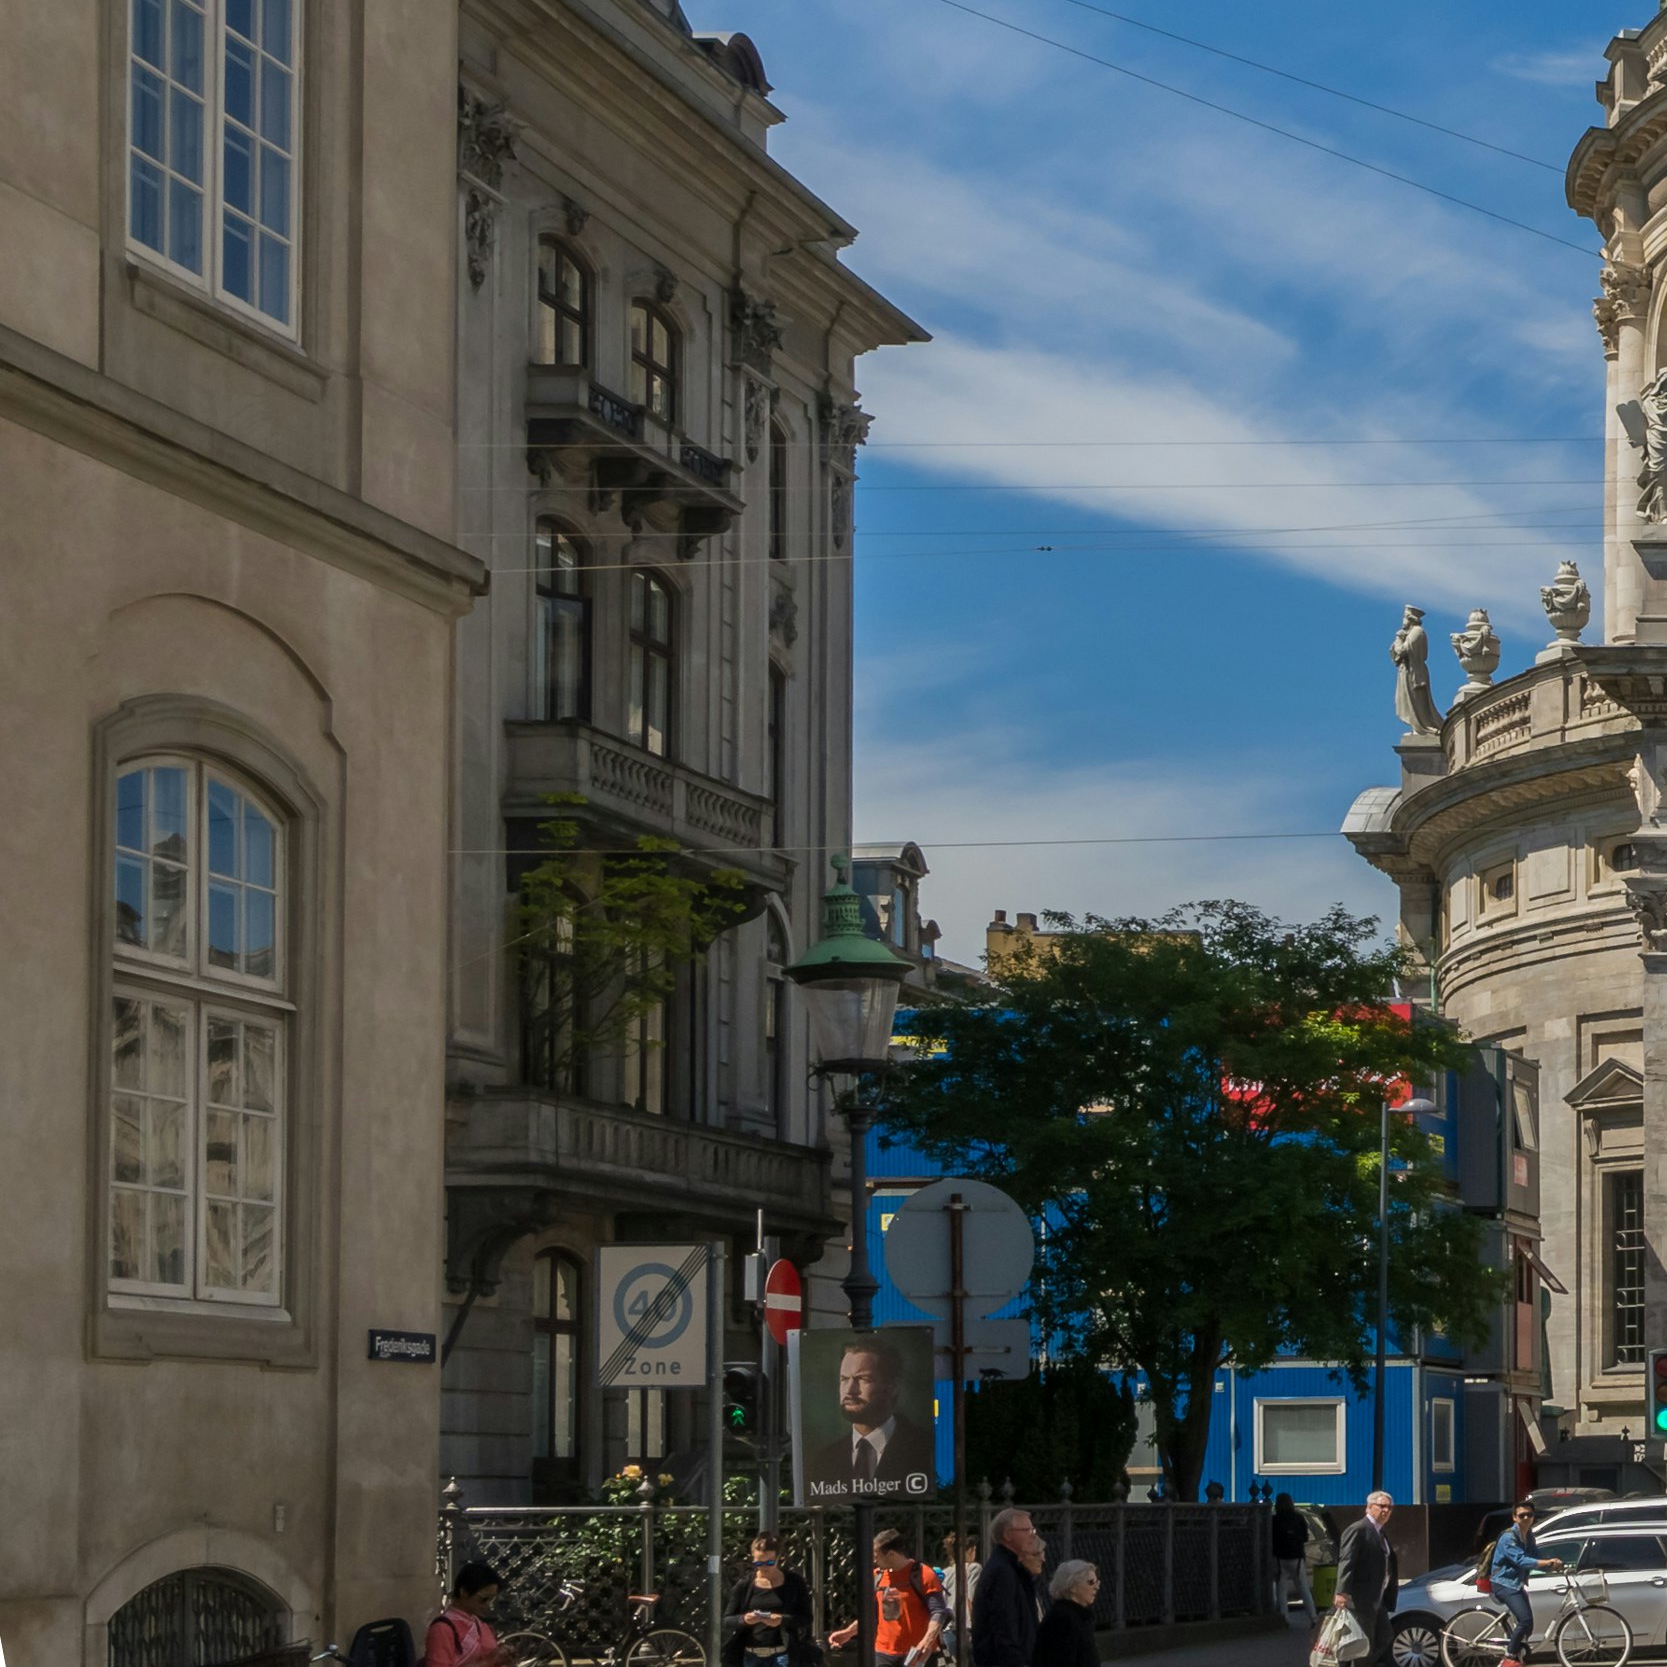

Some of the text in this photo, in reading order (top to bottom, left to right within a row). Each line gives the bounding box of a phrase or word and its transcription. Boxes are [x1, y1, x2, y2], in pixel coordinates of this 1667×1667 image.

[624, 1357, 682, 1375] Zone
[810, 1480, 848, 1496] Mads
[852, 1478, 901, 1496] Holger
